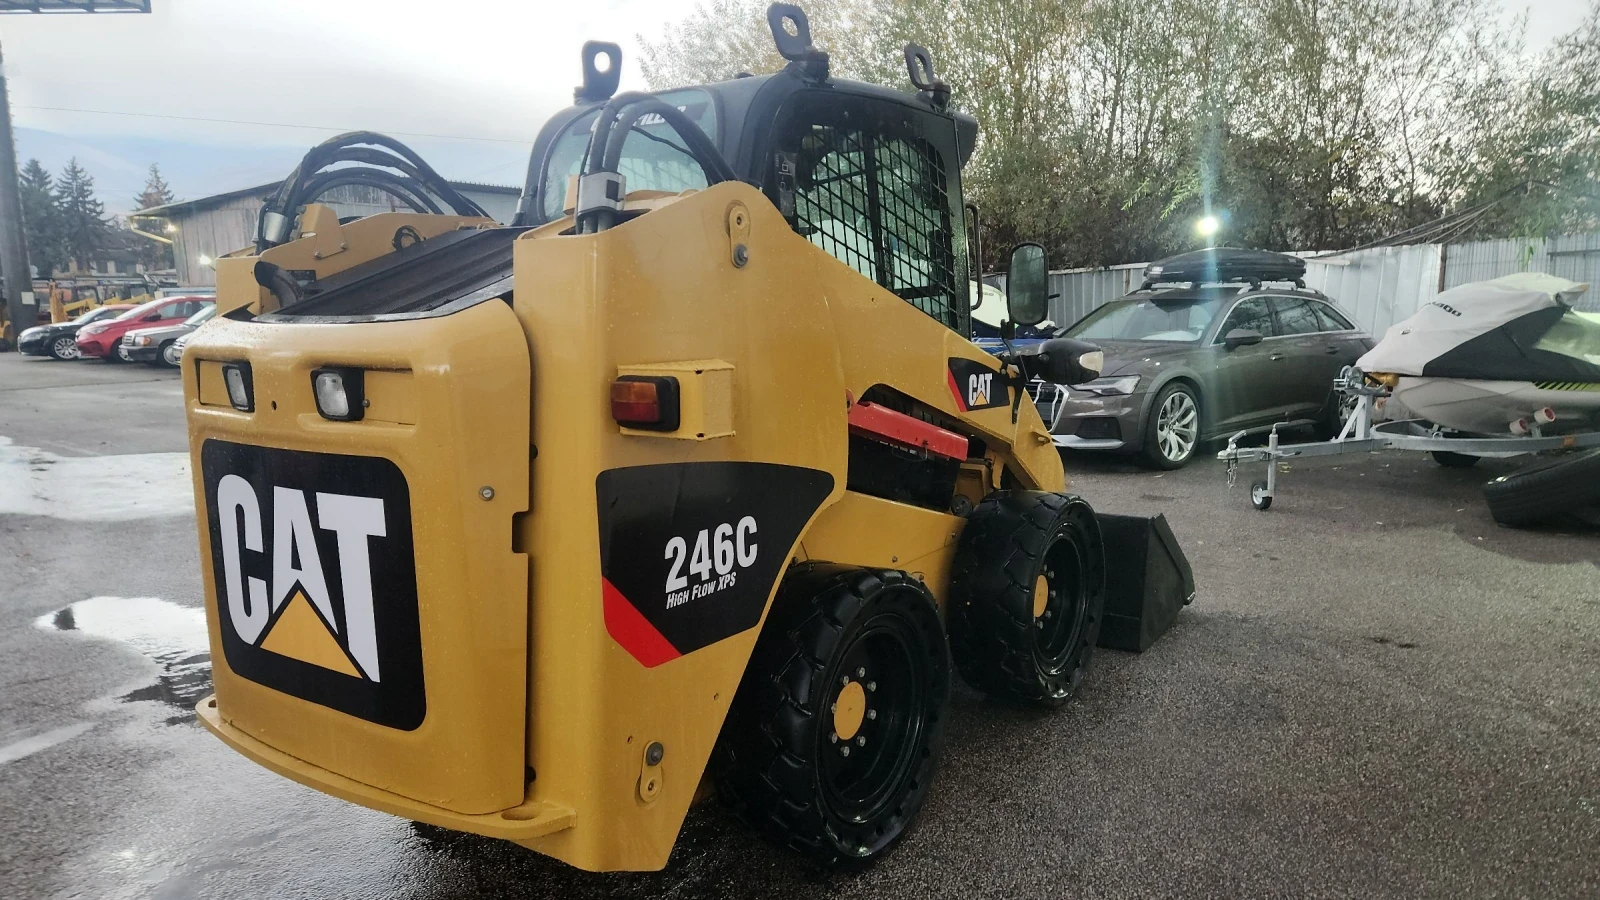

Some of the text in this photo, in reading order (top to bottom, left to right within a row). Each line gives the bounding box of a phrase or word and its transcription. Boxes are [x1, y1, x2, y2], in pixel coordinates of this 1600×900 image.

[968, 373, 993, 406] CAT
[217, 474, 386, 683] CAT
[664, 515, 758, 593] 246C
[666, 571, 736, 609] HIGH FLOW XPS
